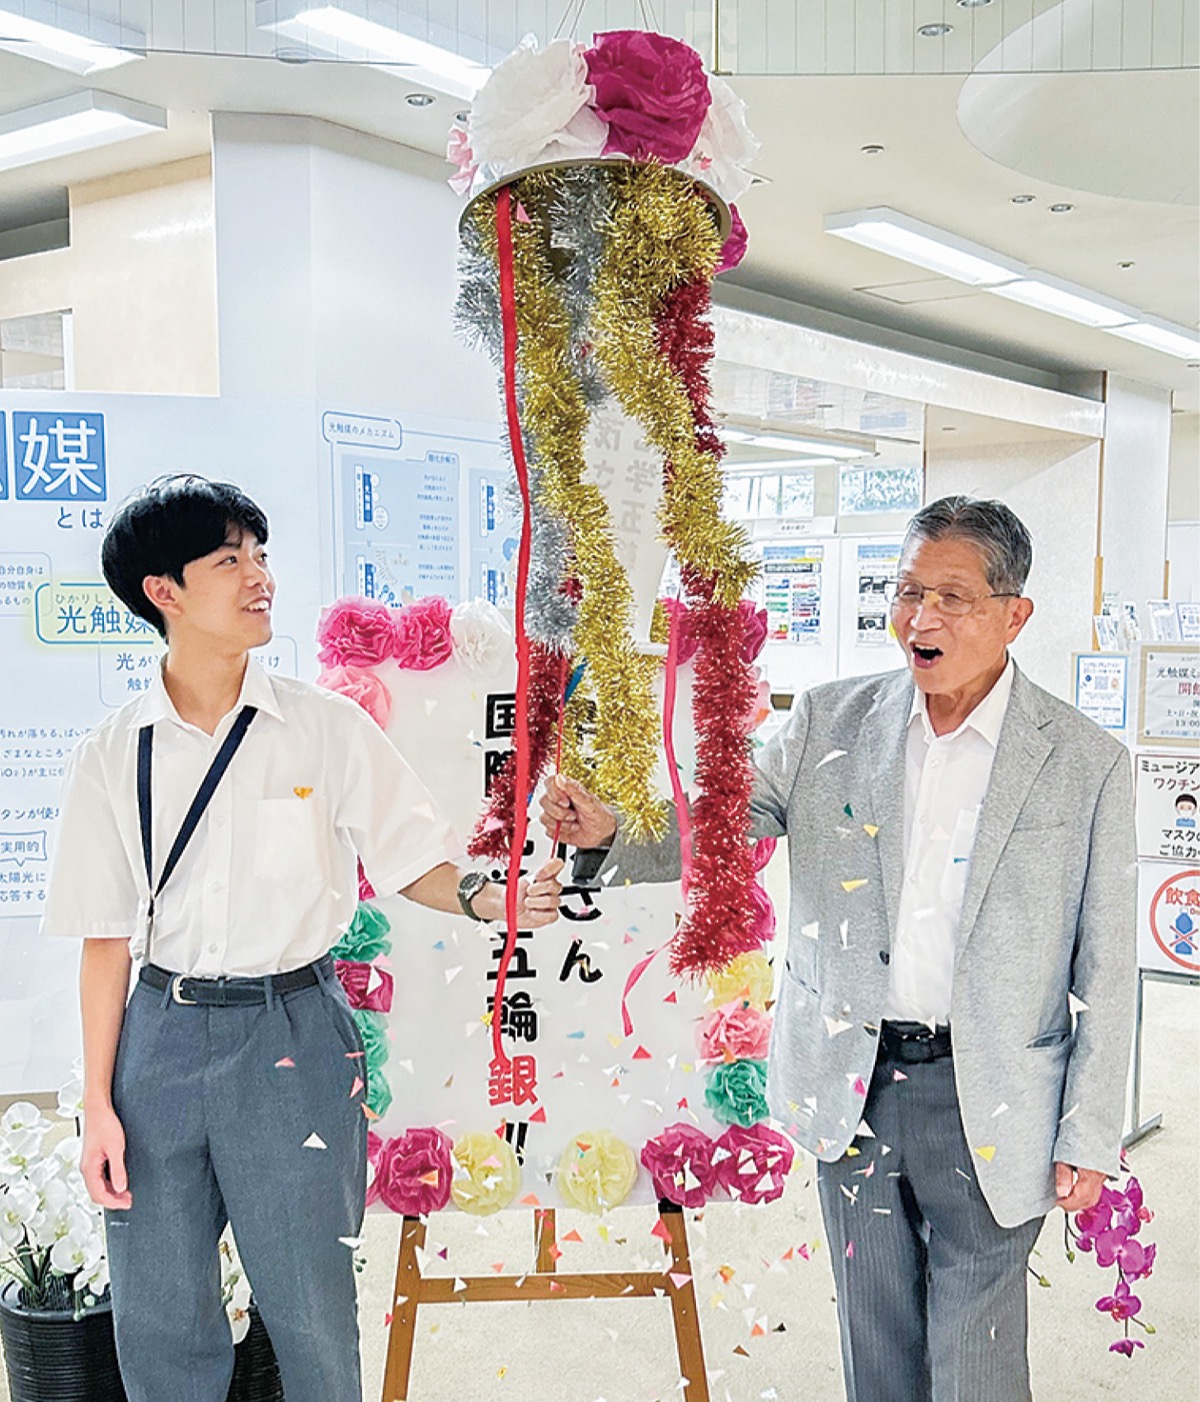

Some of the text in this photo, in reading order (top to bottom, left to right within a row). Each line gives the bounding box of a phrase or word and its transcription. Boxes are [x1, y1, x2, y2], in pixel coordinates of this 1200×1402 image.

[57, 506, 104, 529] とは
[1, 841, 40, 854] 実用的
[1159, 844, 1200, 858] ご協力
